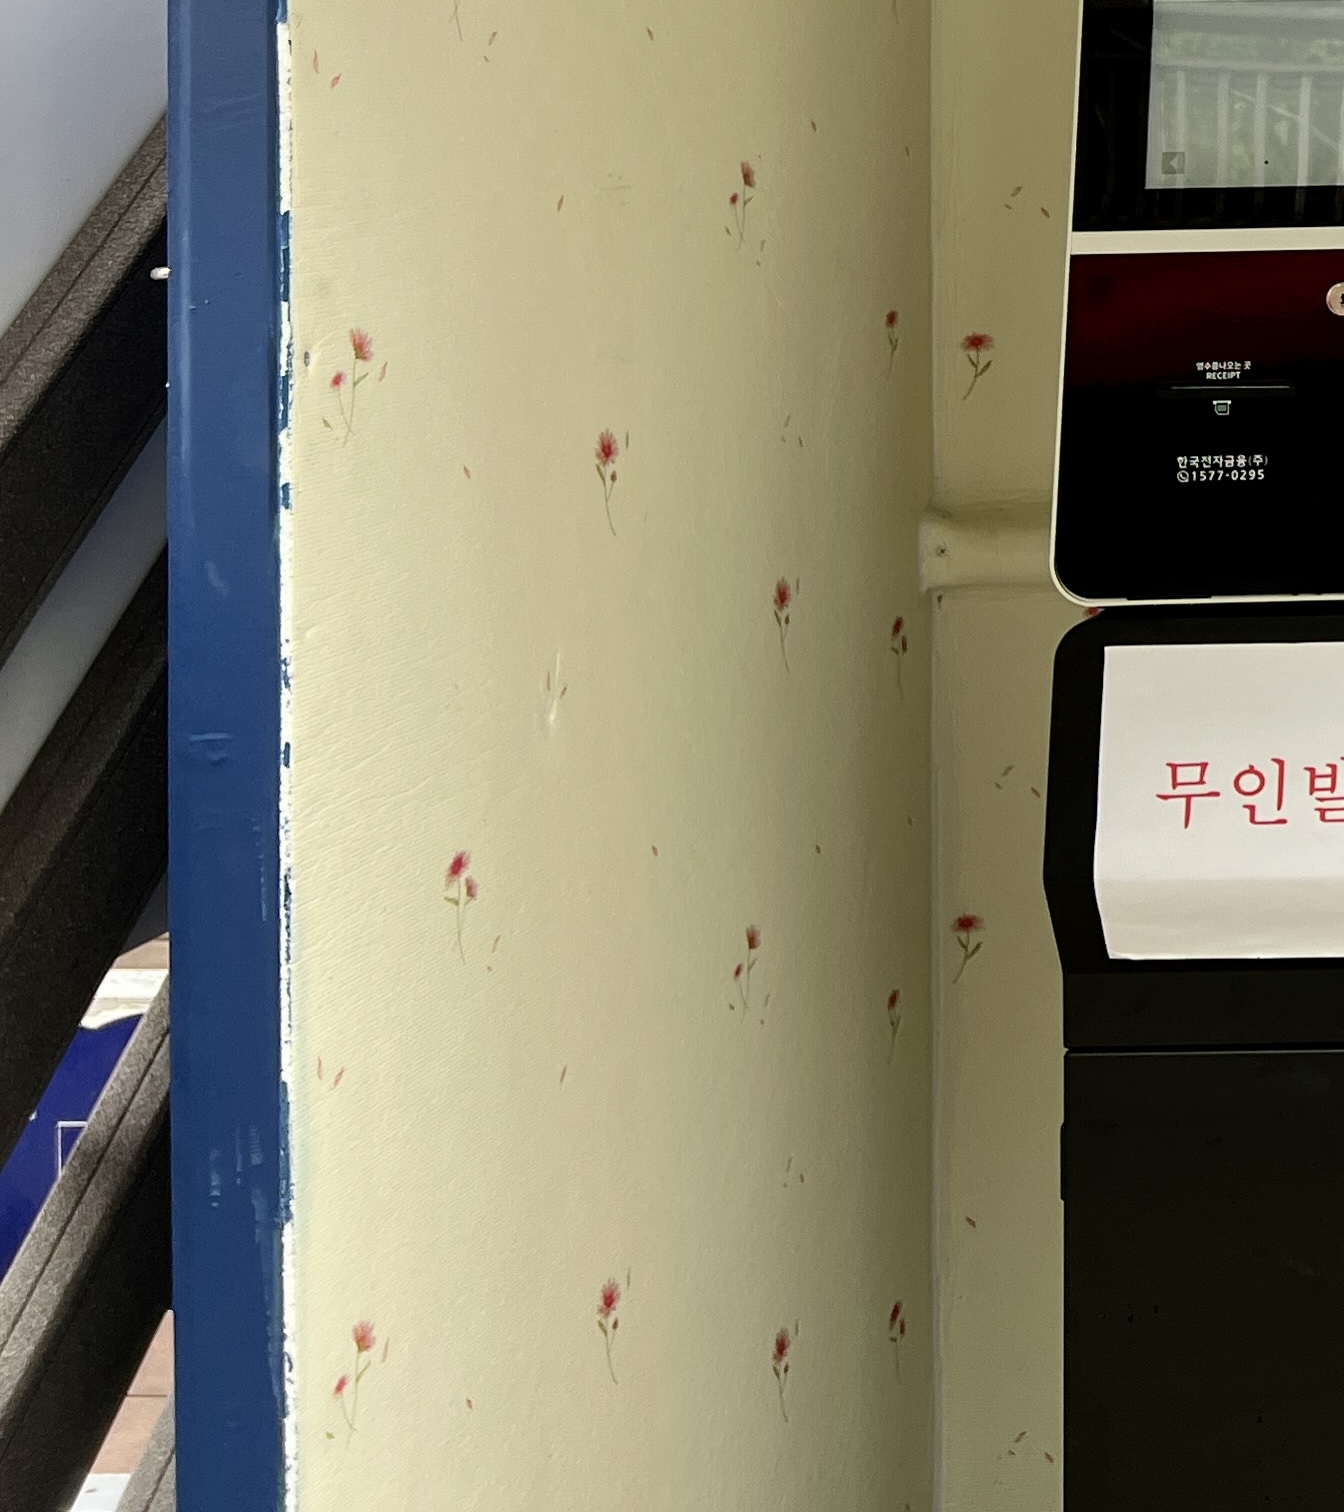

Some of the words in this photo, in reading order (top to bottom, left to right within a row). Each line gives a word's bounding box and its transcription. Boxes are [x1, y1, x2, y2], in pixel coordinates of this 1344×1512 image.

[1206, 371, 1241, 380] RECEIPT
[1177, 454, 1268, 469] 한국전자금융(주)
[1192, 469, 1265, 481] 1577-0295
